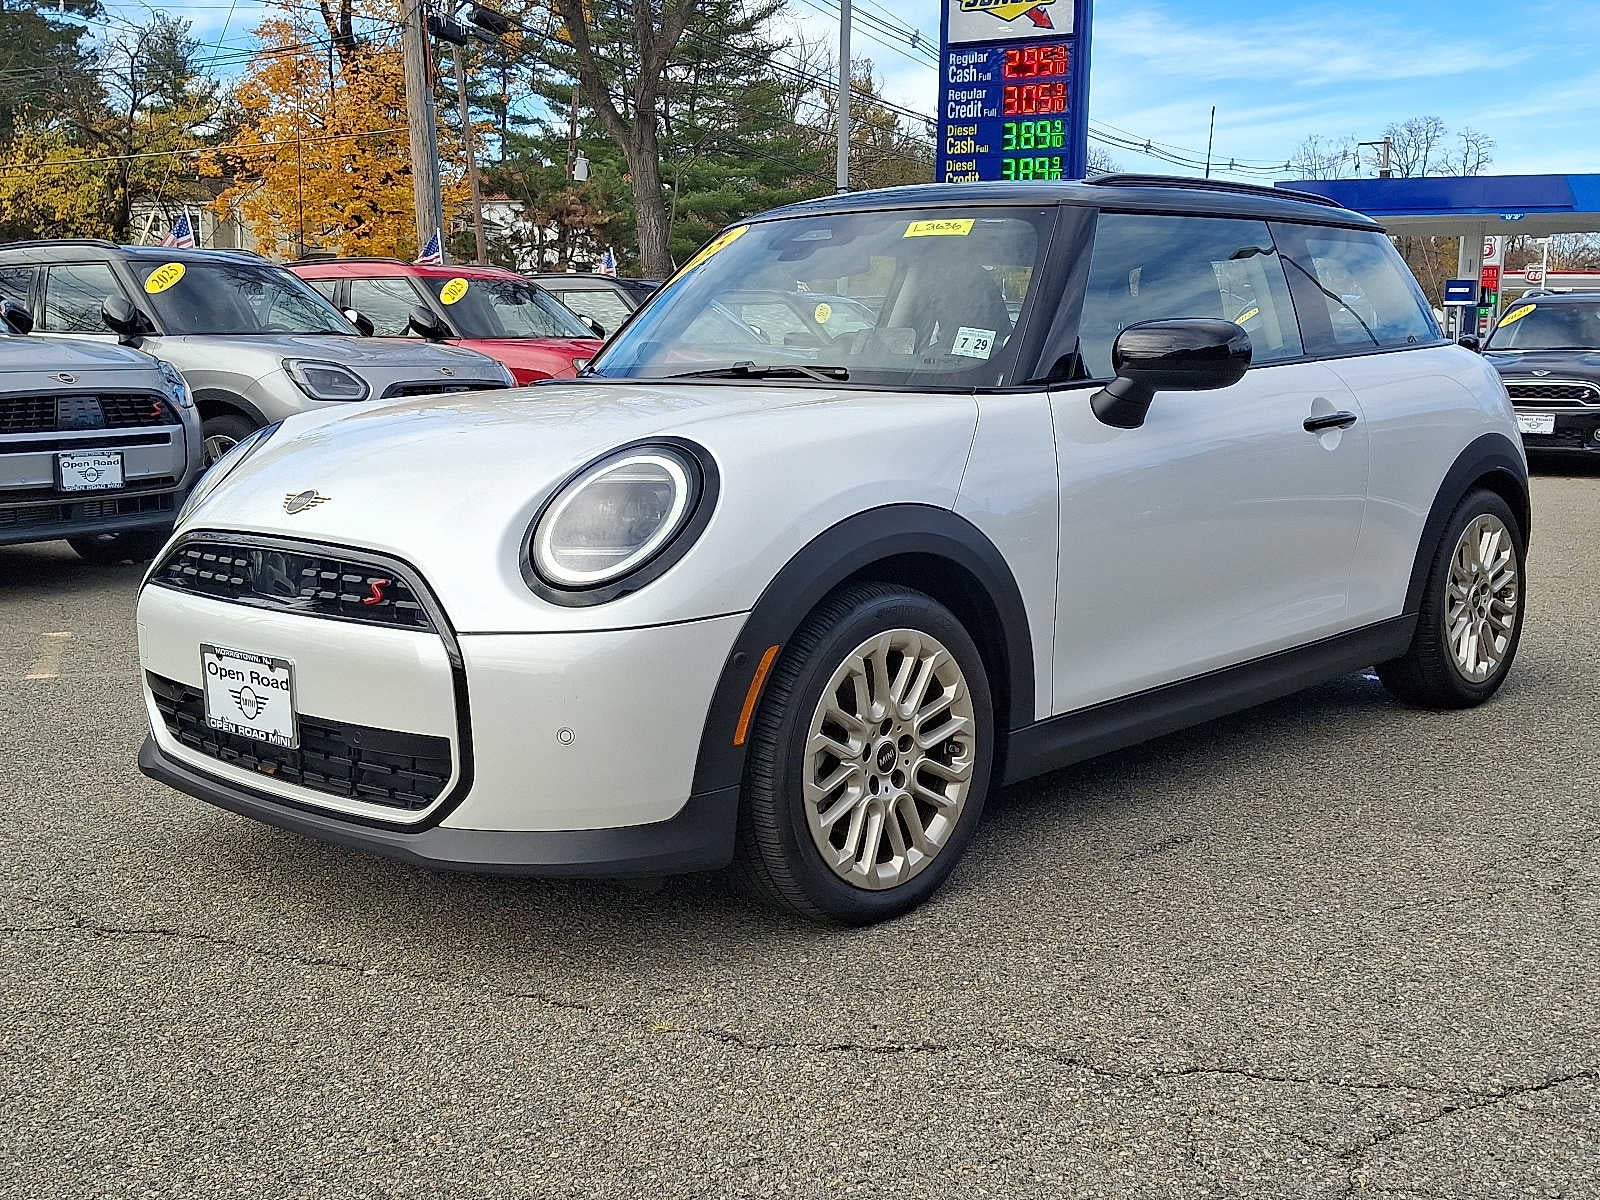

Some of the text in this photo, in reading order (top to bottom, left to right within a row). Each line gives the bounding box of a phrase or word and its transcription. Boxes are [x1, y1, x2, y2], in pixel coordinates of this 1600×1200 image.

[949, 52, 988, 66] Regular
[948, 65, 992, 83] Cash Full
[948, 88, 987, 102] Regular
[947, 101, 997, 119] Credit Full
[947, 123, 977, 136] Diesel
[946, 137, 989, 154] Cash Full
[946, 160, 976, 172] Diesel
[151, 265, 179, 289] 2025
[444, 280, 464, 300] 2025
[960, 337, 988, 350] 7 29
[62, 459, 120, 469] Open Road
[363, 578, 391, 605] S
[207, 661, 289, 692] Open Road
[241, 696, 256, 709] MINI
[210, 718, 291, 747] OPEN ROAD MINI
[878, 748, 895, 767] MINI
